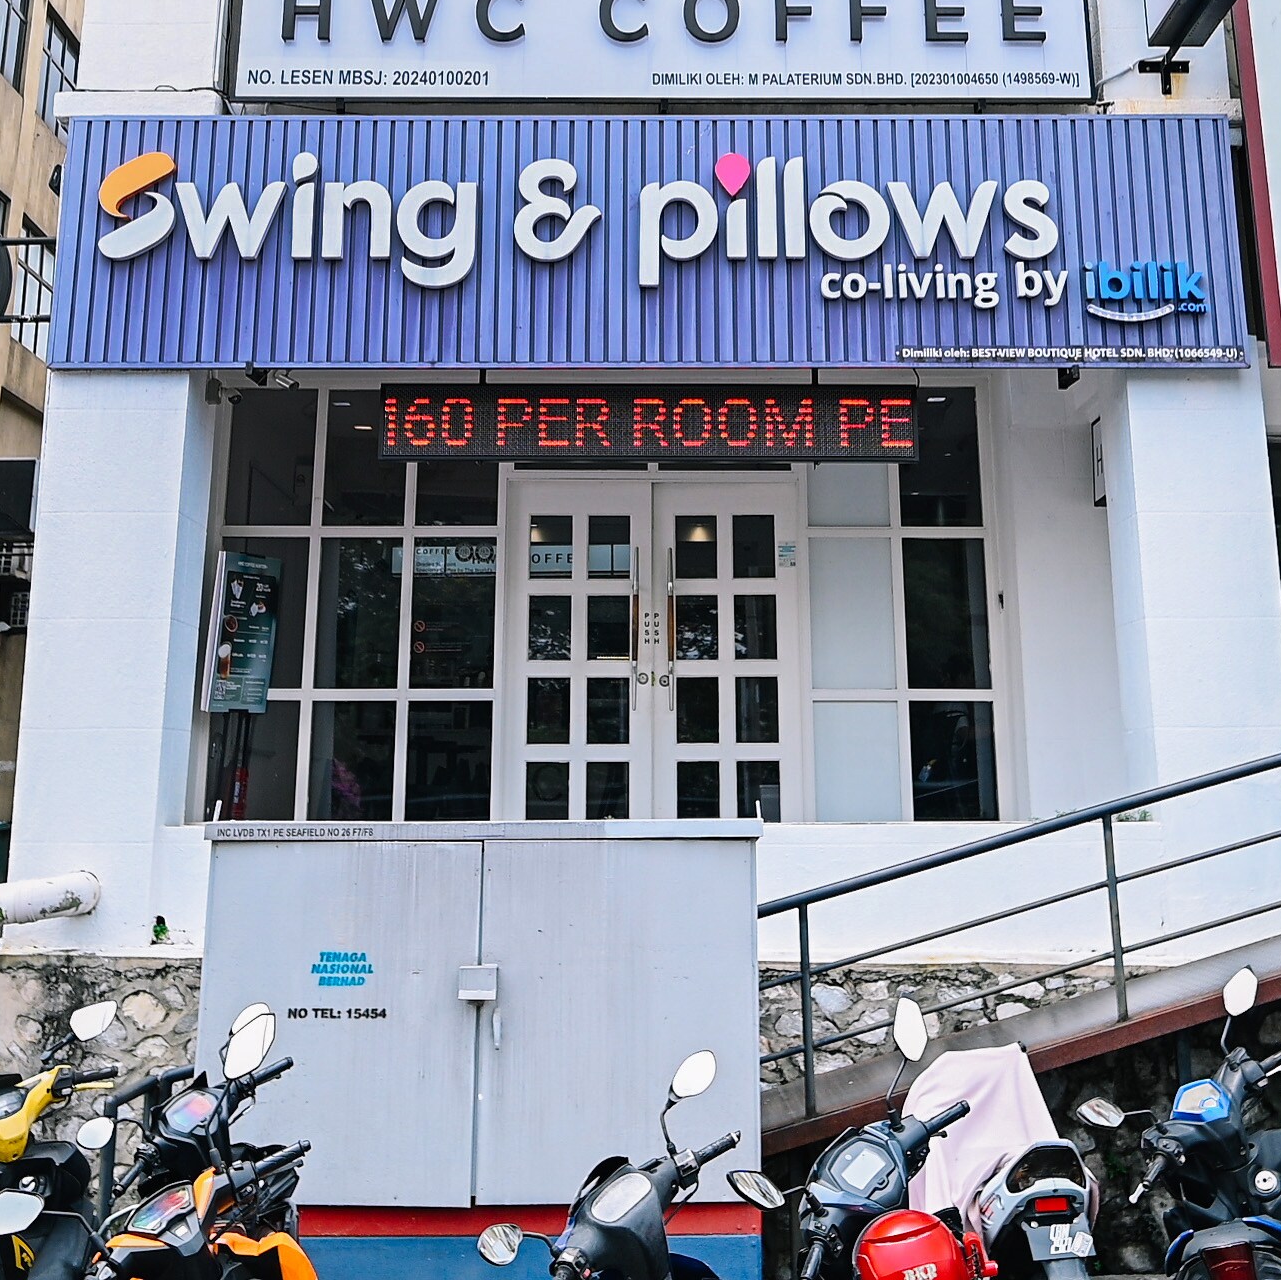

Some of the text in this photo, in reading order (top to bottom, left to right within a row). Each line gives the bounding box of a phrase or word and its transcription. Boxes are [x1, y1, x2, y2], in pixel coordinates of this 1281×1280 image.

[247, 70, 490, 87] NO. LESEN MBSJ: 20240100201
[652, 73, 703, 86] DIMILIKI
[706, 73, 744, 86] OLEH:
[748, 73, 759, 86] M
[762, 73, 842, 86] PALATERIUM
[97, 151, 1059, 289] Swing & pillows
[820, 261, 1206, 309] co-living by ibilik
[1178, 302, 1208, 313] .com
[944, 348, 969, 359] oleh:
[1028, 348, 1082, 359] BOUTIQUE
[1084, 348, 1118, 359] HOTEL
[1120, 348, 1145, 359] SDN.
[384, 397, 913, 448] 160 PER ROOM PE
[233, 828, 254, 837] LVDB
[273, 828, 284, 837] PE
[285, 828, 325, 837] SEAFIELD
[327, 828, 339, 837] NO
[319, 952, 367, 962] TENAGA
[311, 964, 374, 974] NASIONAL
[287, 1008, 387, 1019] NO TEL: 15454
